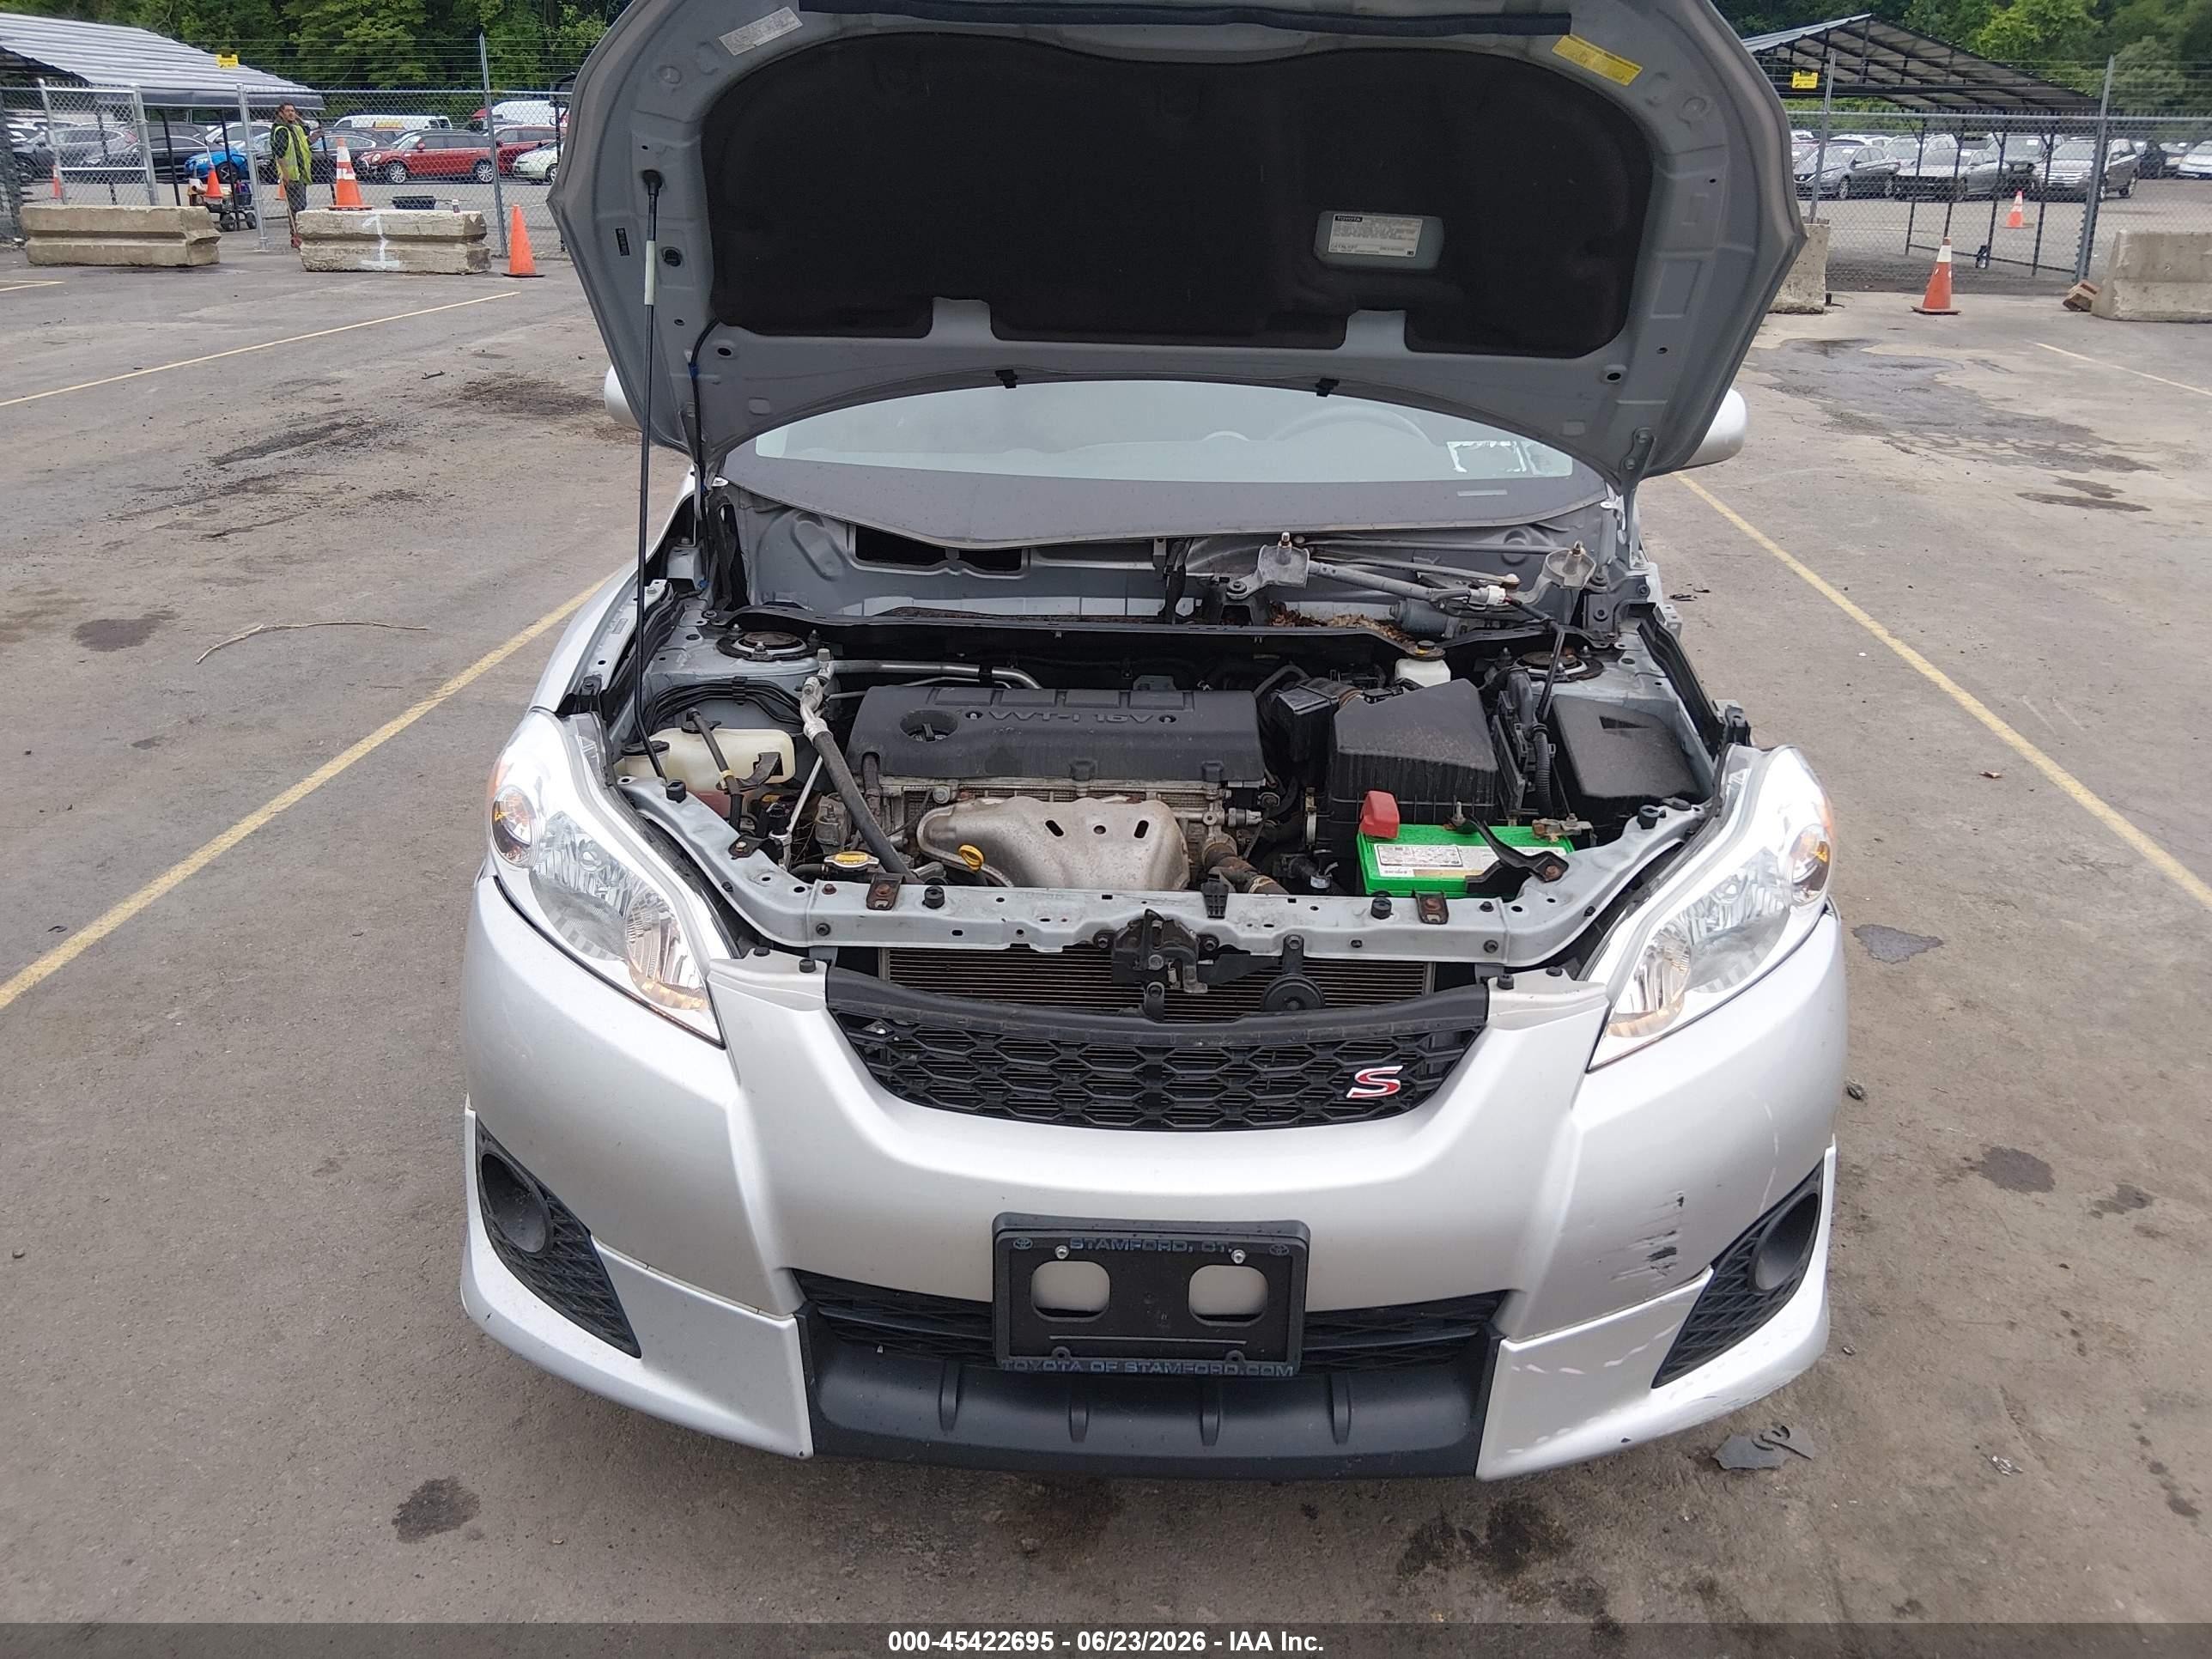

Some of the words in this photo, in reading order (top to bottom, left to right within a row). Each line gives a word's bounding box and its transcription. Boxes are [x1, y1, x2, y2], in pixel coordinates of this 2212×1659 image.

[1346, 1065, 1403, 1098] S
[1002, 1359, 1083, 1372] TOYOTA
[1091, 1361, 1118, 1373] OF
[1124, 1361, 1294, 1377] STAMFORD.COM
